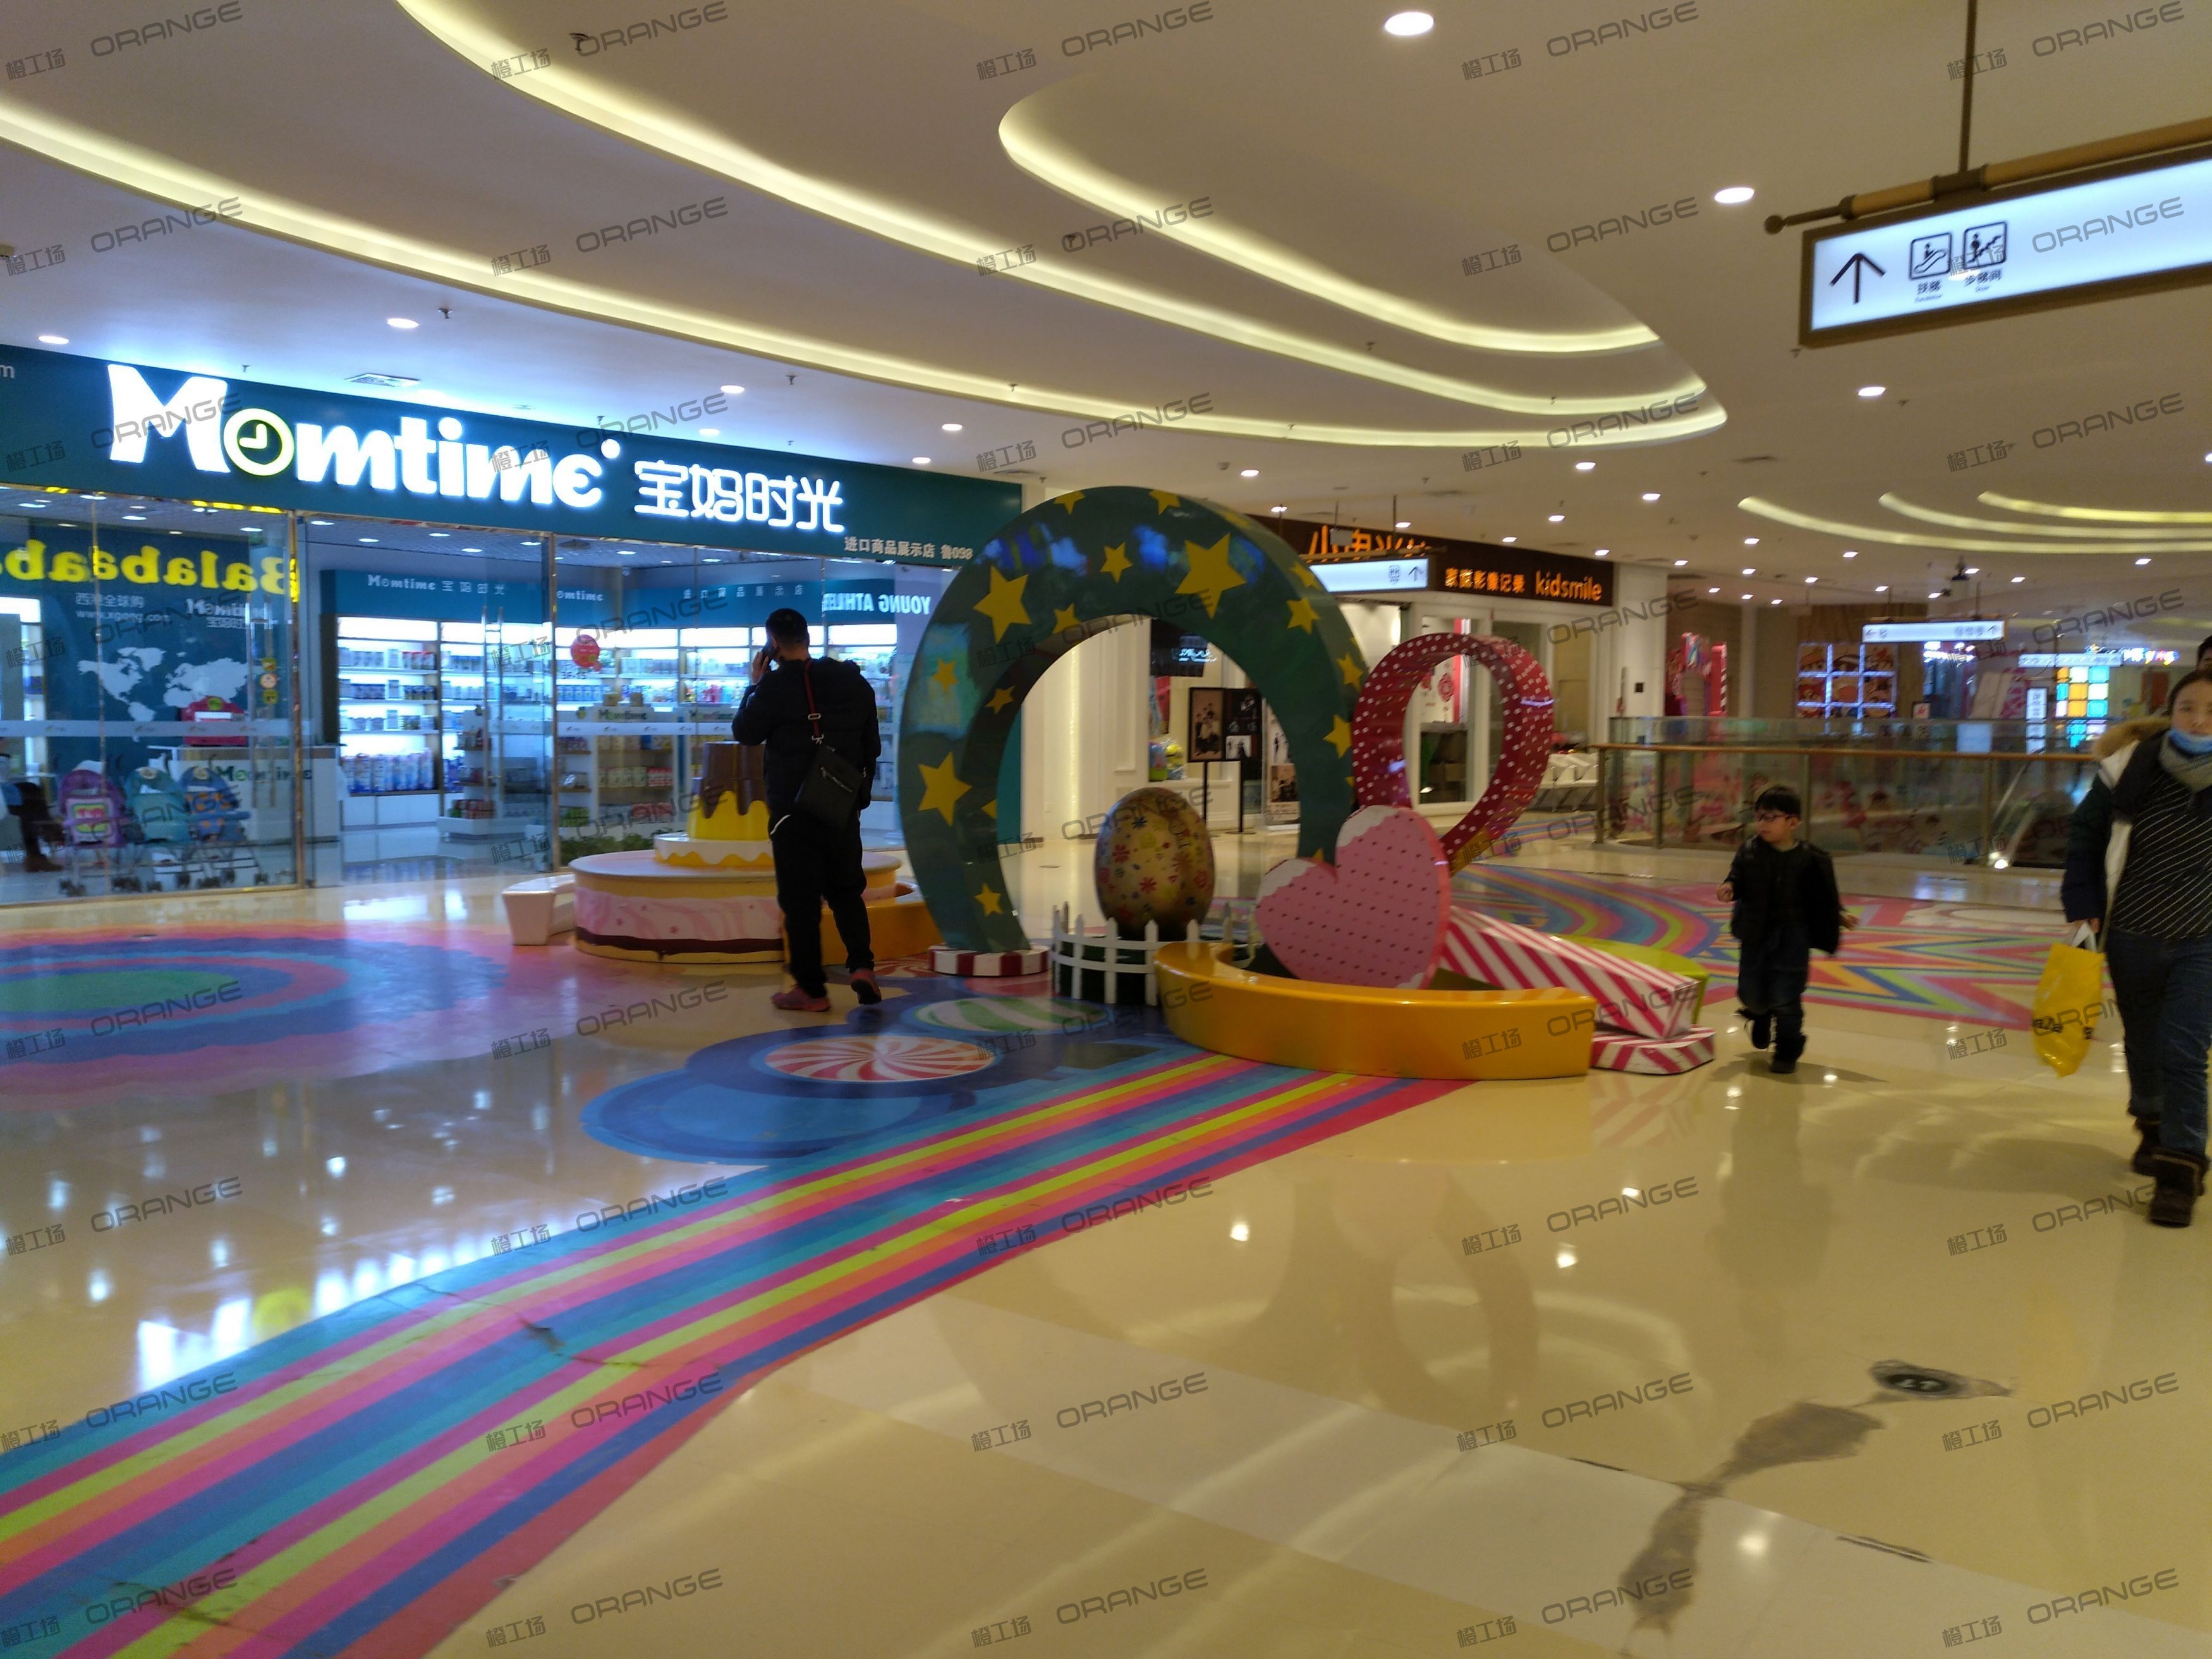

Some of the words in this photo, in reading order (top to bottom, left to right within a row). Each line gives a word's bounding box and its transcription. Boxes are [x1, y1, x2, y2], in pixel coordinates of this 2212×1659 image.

[107, 364, 604, 507] Momtime
[634, 459, 845, 533] 宝妈时光
[844, 536, 935, 558] 进口商品展示店
[367, 574, 436, 591] Momtime
[1535, 570, 1603, 601] kidsmile
[556, 590, 604, 602] omtime
